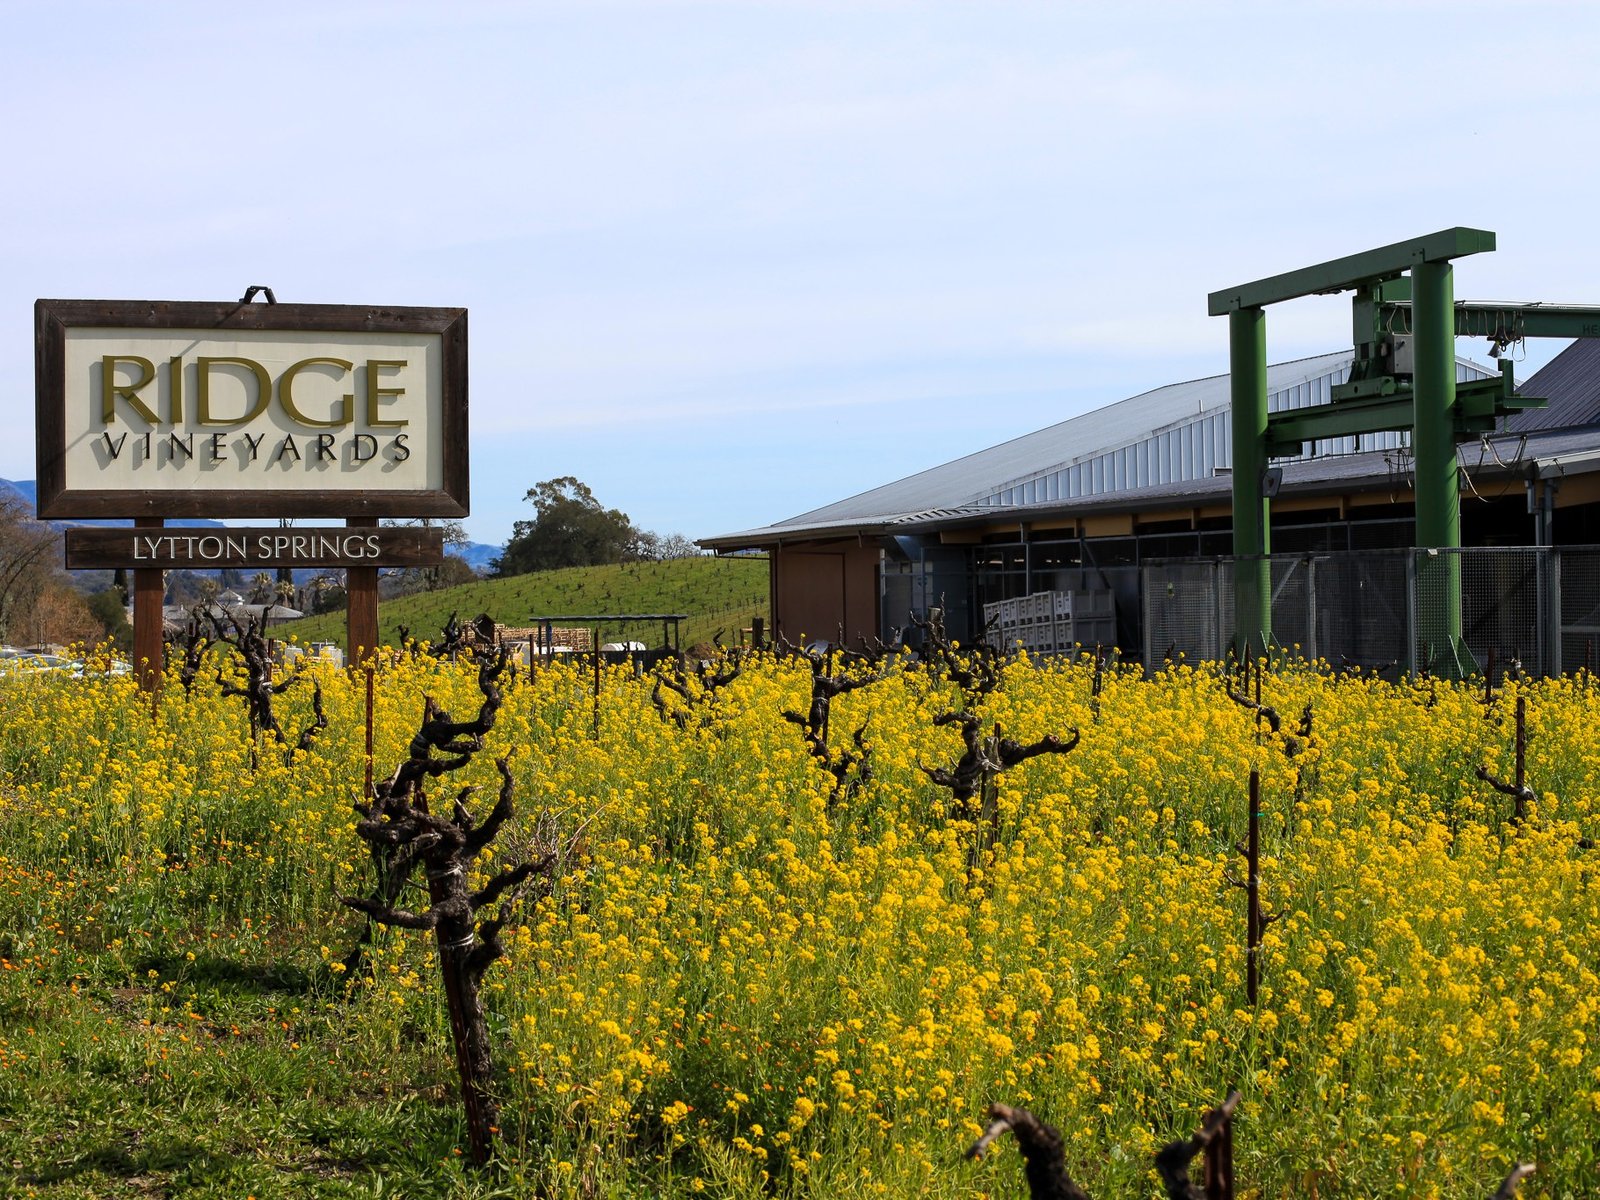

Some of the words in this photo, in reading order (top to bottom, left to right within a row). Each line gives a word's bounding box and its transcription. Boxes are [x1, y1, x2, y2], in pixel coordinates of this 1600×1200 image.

[1583, 324, 1600, 335] HE
[102, 355, 408, 427] RIDGE
[103, 432, 411, 462] VINEYARDS
[133, 536, 247, 560] LYTTON
[258, 535, 381, 559] SPRINGS
